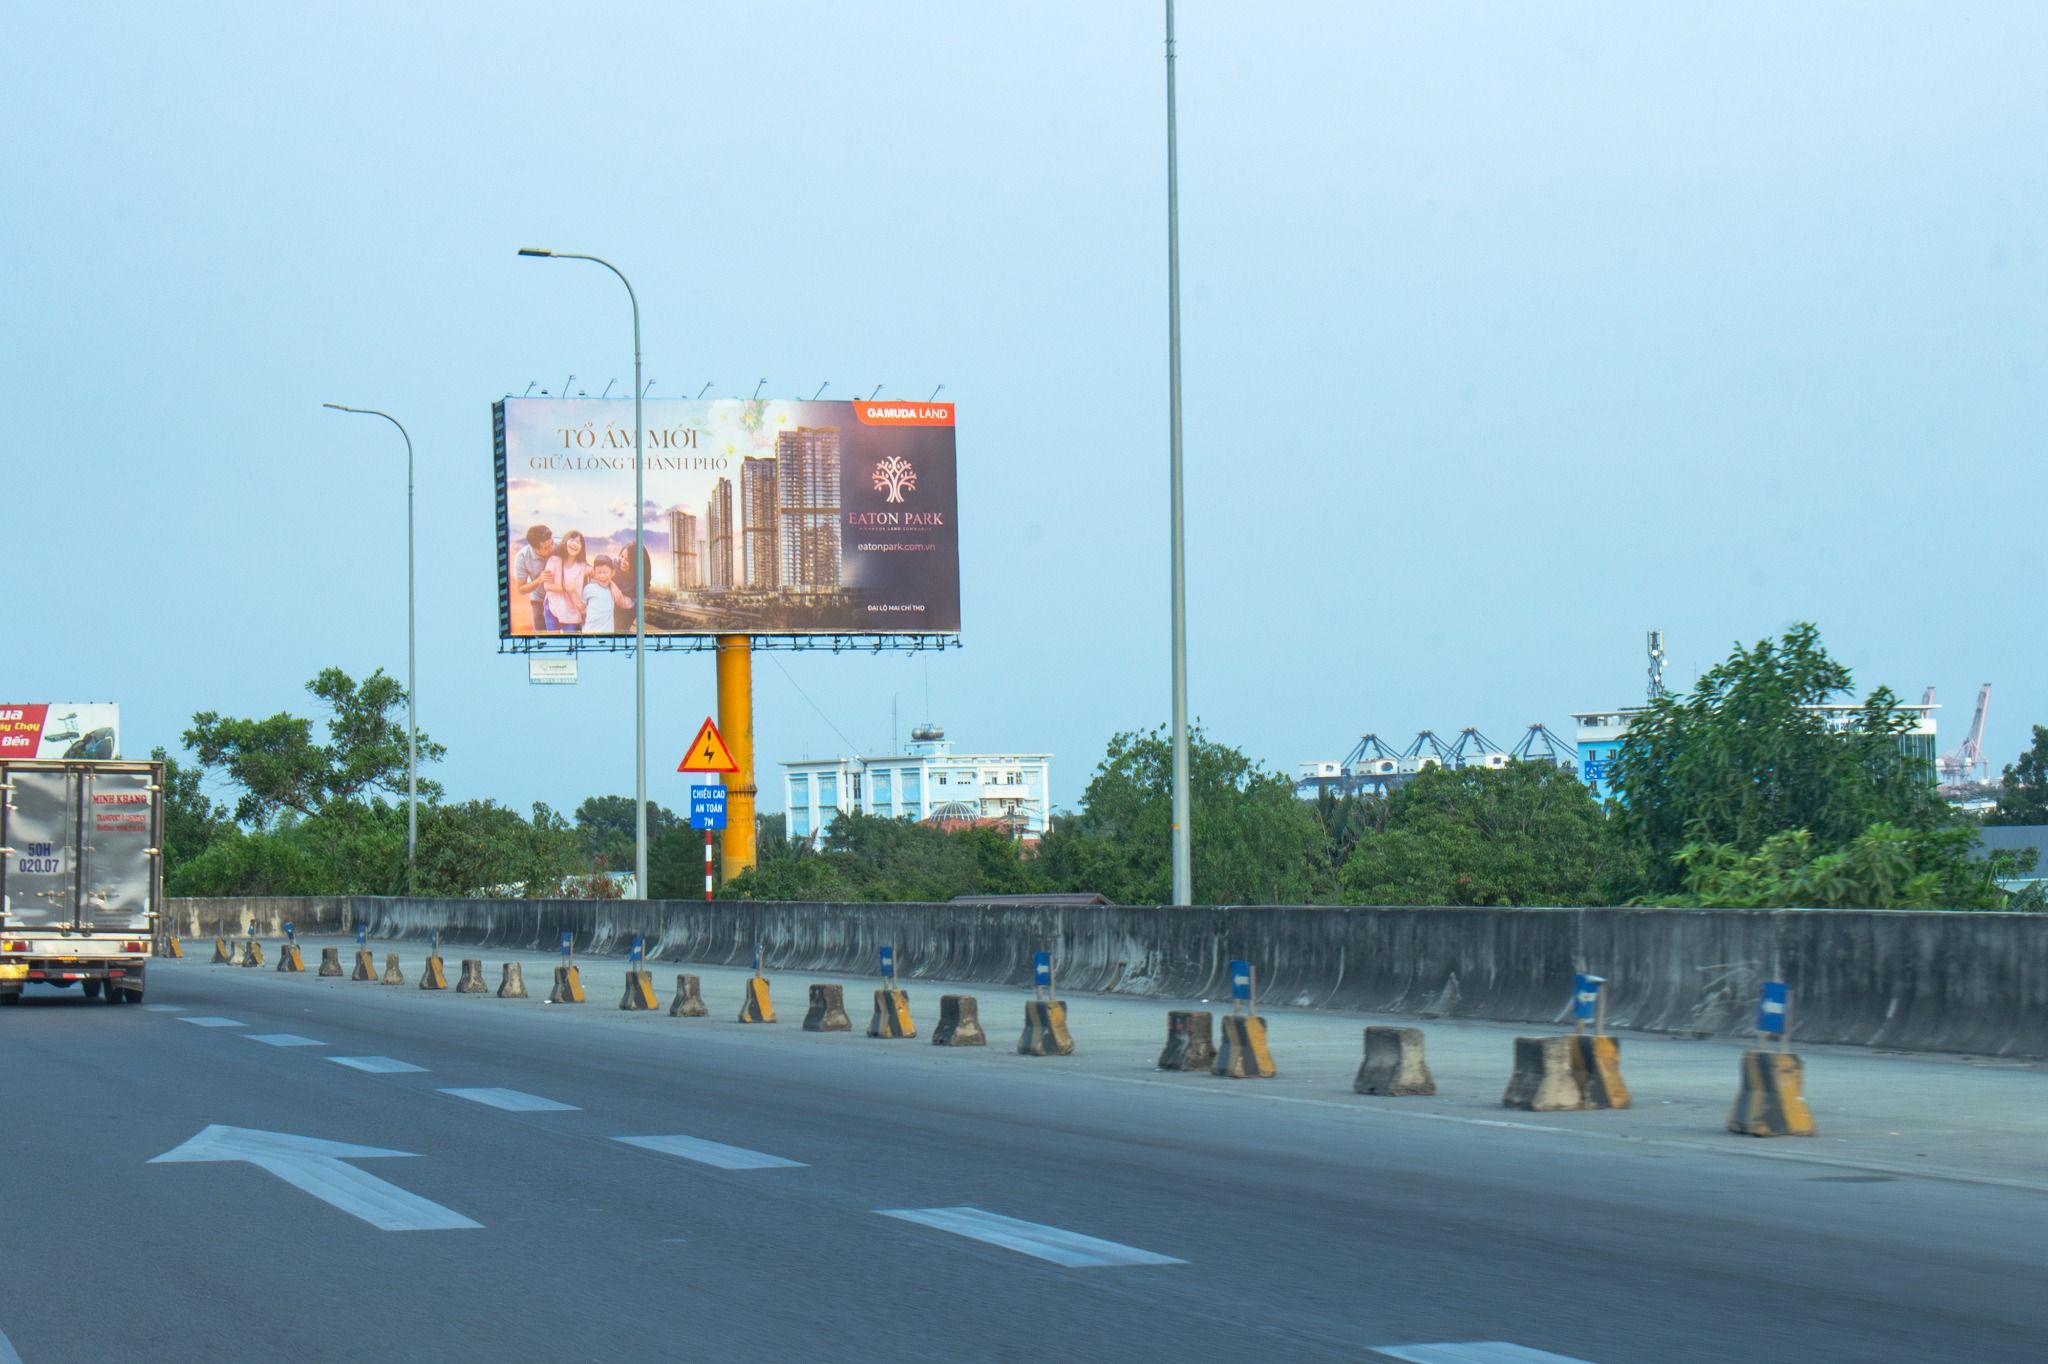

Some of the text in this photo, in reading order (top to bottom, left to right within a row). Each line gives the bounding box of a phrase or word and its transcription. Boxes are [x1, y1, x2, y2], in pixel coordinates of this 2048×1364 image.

[867, 408, 948, 419] GAMUDA LAND
[557, 422, 596, 449] TỔ
[648, 423, 699, 449] MỚI
[529, 453, 575, 470] GIỮA
[577, 454, 624, 470] LÒNG
[694, 453, 728, 470] PHỐ
[848, 512, 943, 525] EATON PARK
[857, 542, 936, 552] eatonpark.com.vn
[888, 604, 900, 612] MAI
[0, 709, 23, 720] ua
[14, 722, 40, 732] Chạy
[1, 734, 30, 746] Đến
[116, 794, 147, 805] KHANG
[712, 789, 725, 799] CAO
[695, 802, 723, 813] AN TOÀN
[703, 816, 714, 827] 7M
[27, 842, 51, 857] 50H
[19, 859, 60, 873] 020.07
